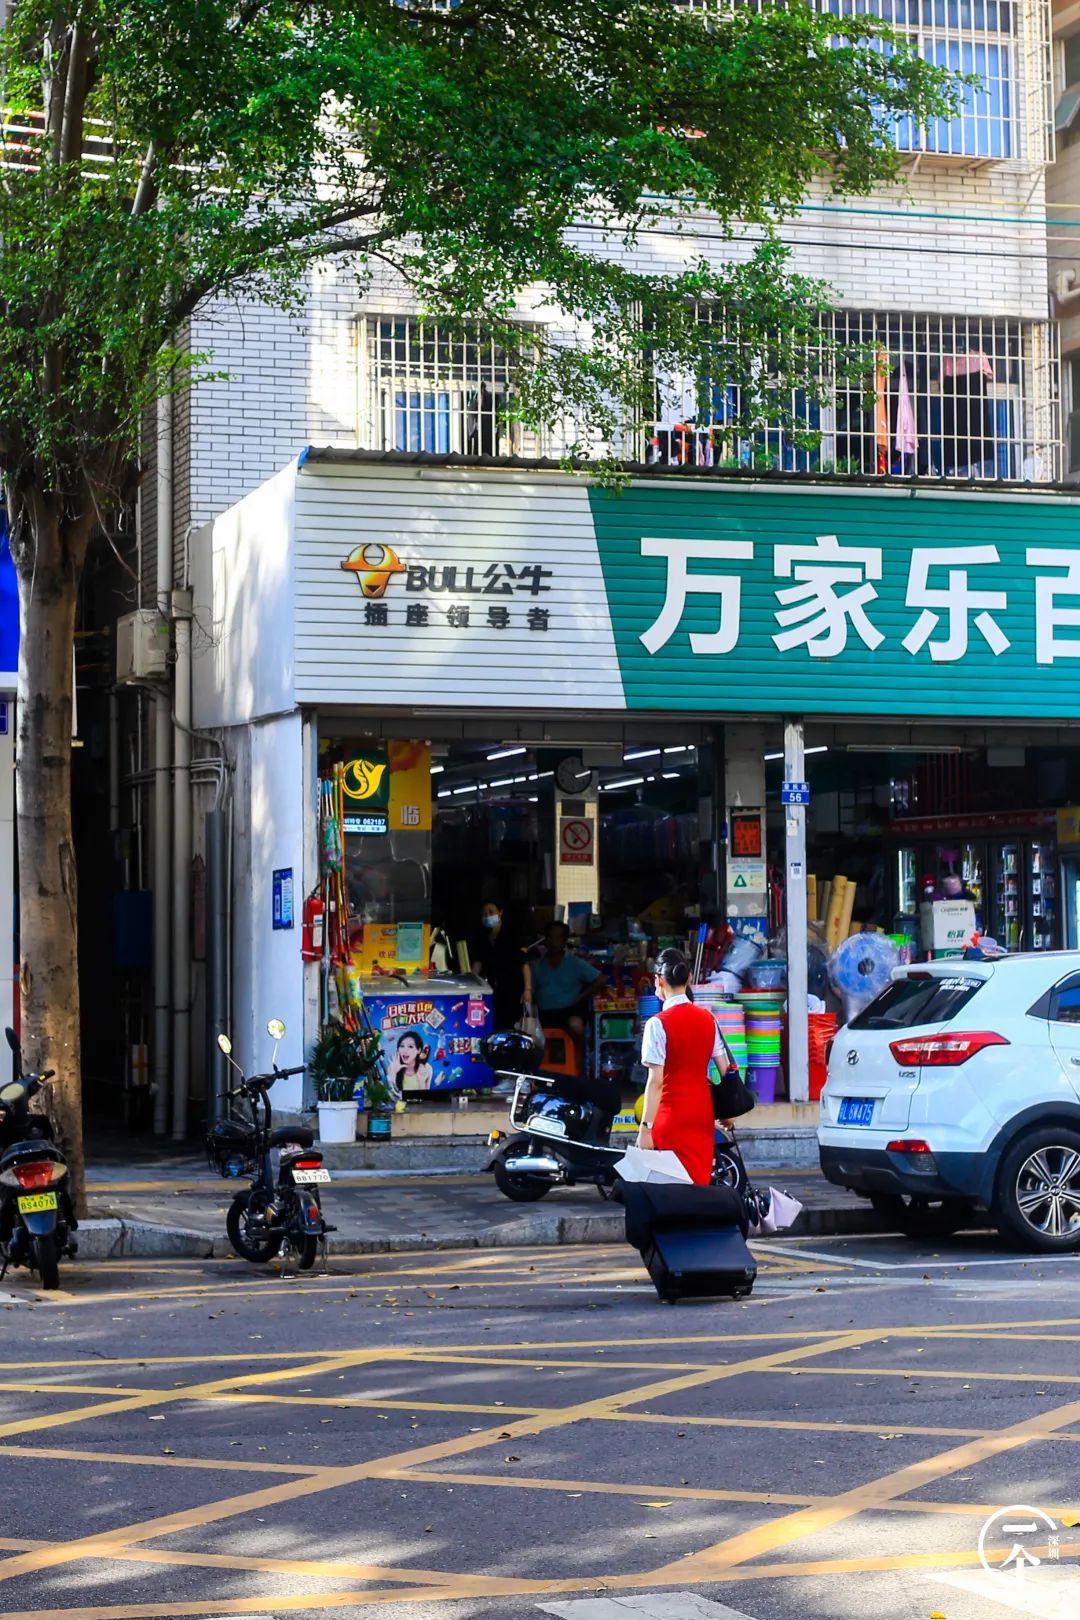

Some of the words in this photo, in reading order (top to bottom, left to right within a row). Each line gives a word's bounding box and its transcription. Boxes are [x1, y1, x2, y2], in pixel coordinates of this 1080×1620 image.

[364, 601, 550, 632] 插座领导者
[789, 792, 802, 803] 56
[20, 1197, 55, 1211] BS4070
